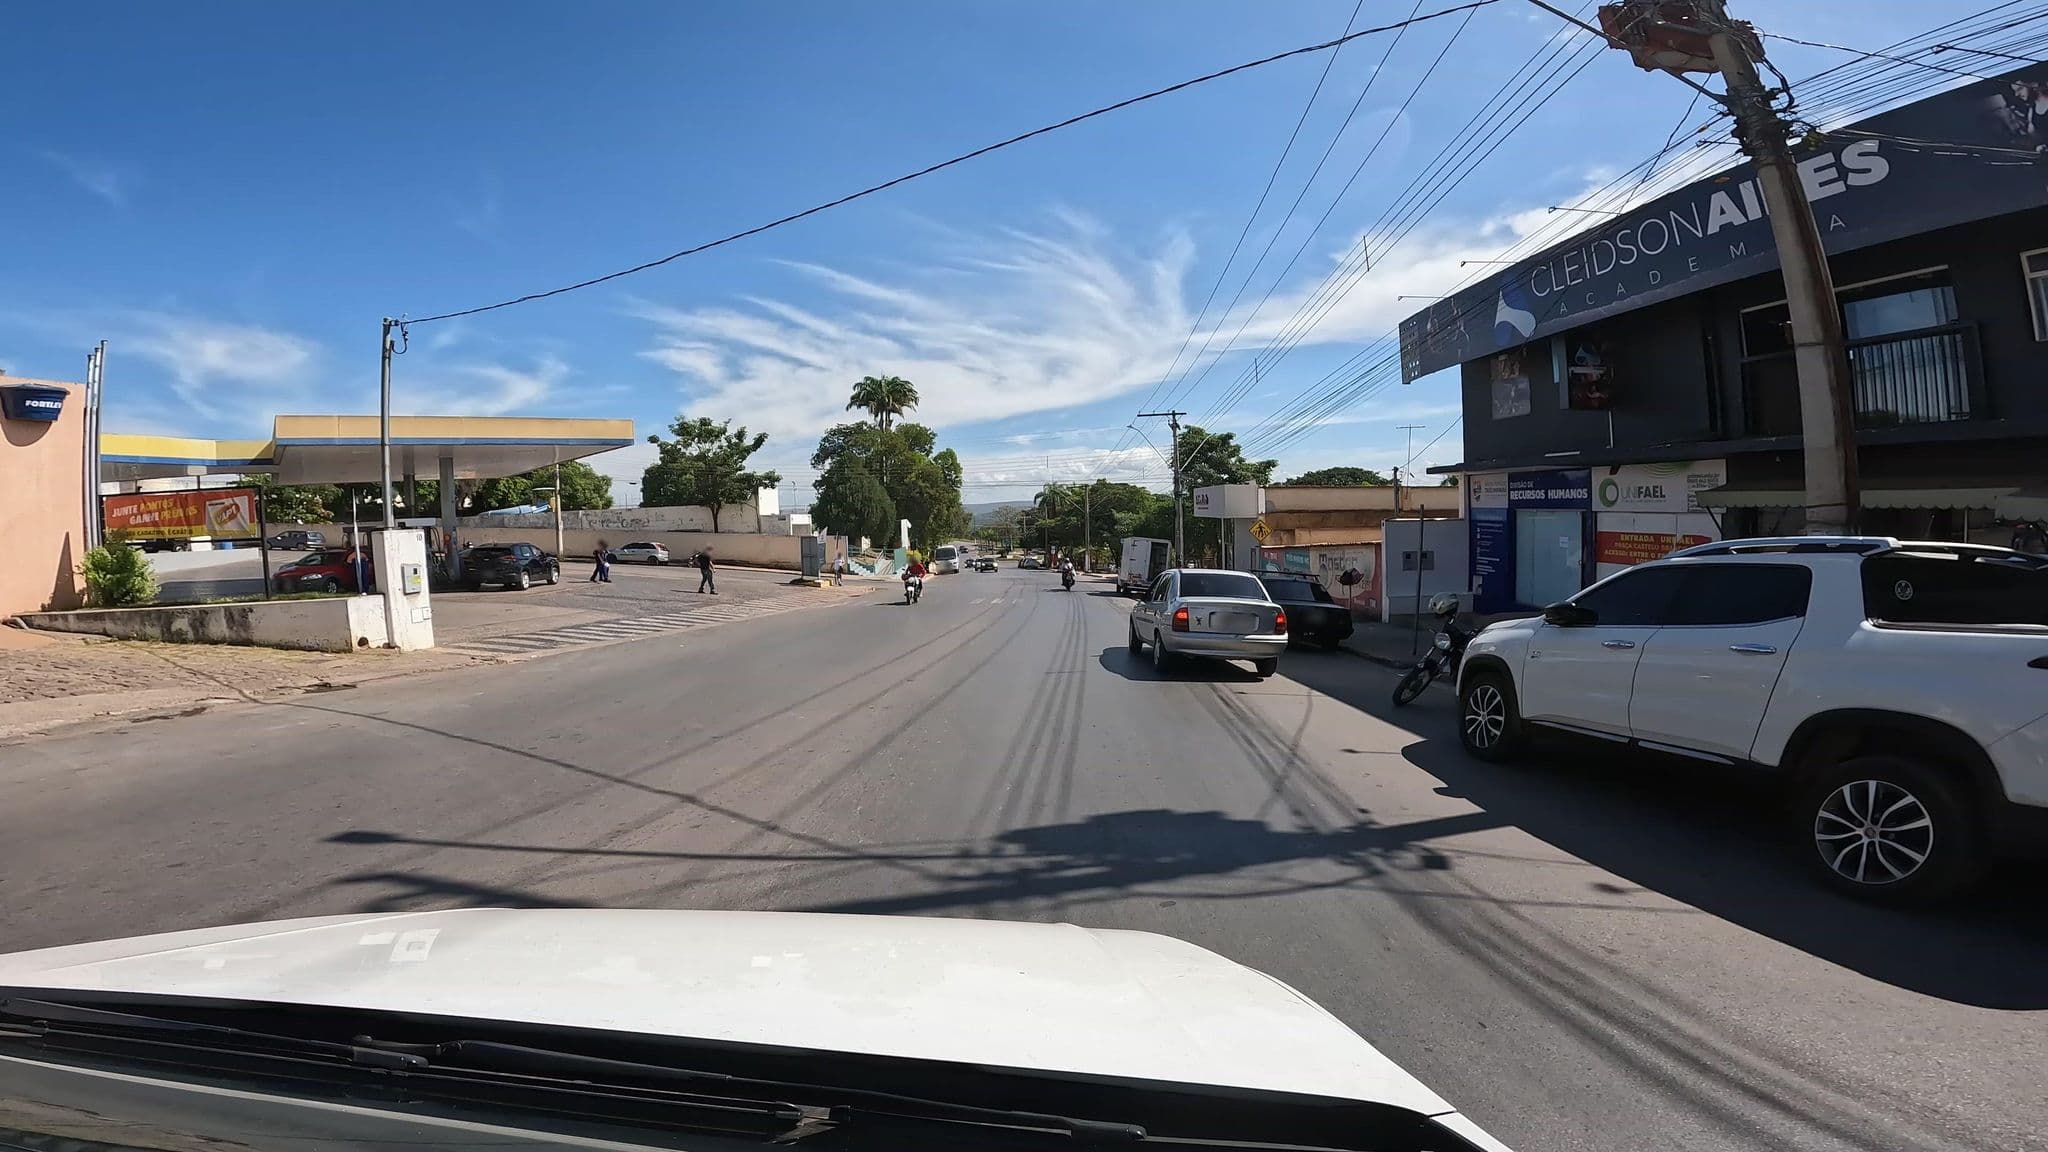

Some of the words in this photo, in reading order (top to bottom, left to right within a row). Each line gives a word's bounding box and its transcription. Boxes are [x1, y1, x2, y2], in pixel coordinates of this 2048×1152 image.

[1559, 213, 1846, 316] ACADEMA
[1510, 490, 1545, 500] RECURSOS
[1548, 488, 1588, 500] HUMANOS
[112, 505, 138, 518] JUNTE
[129, 512, 160, 525] GANHE
[1620, 535, 1654, 543] ENTRADA
